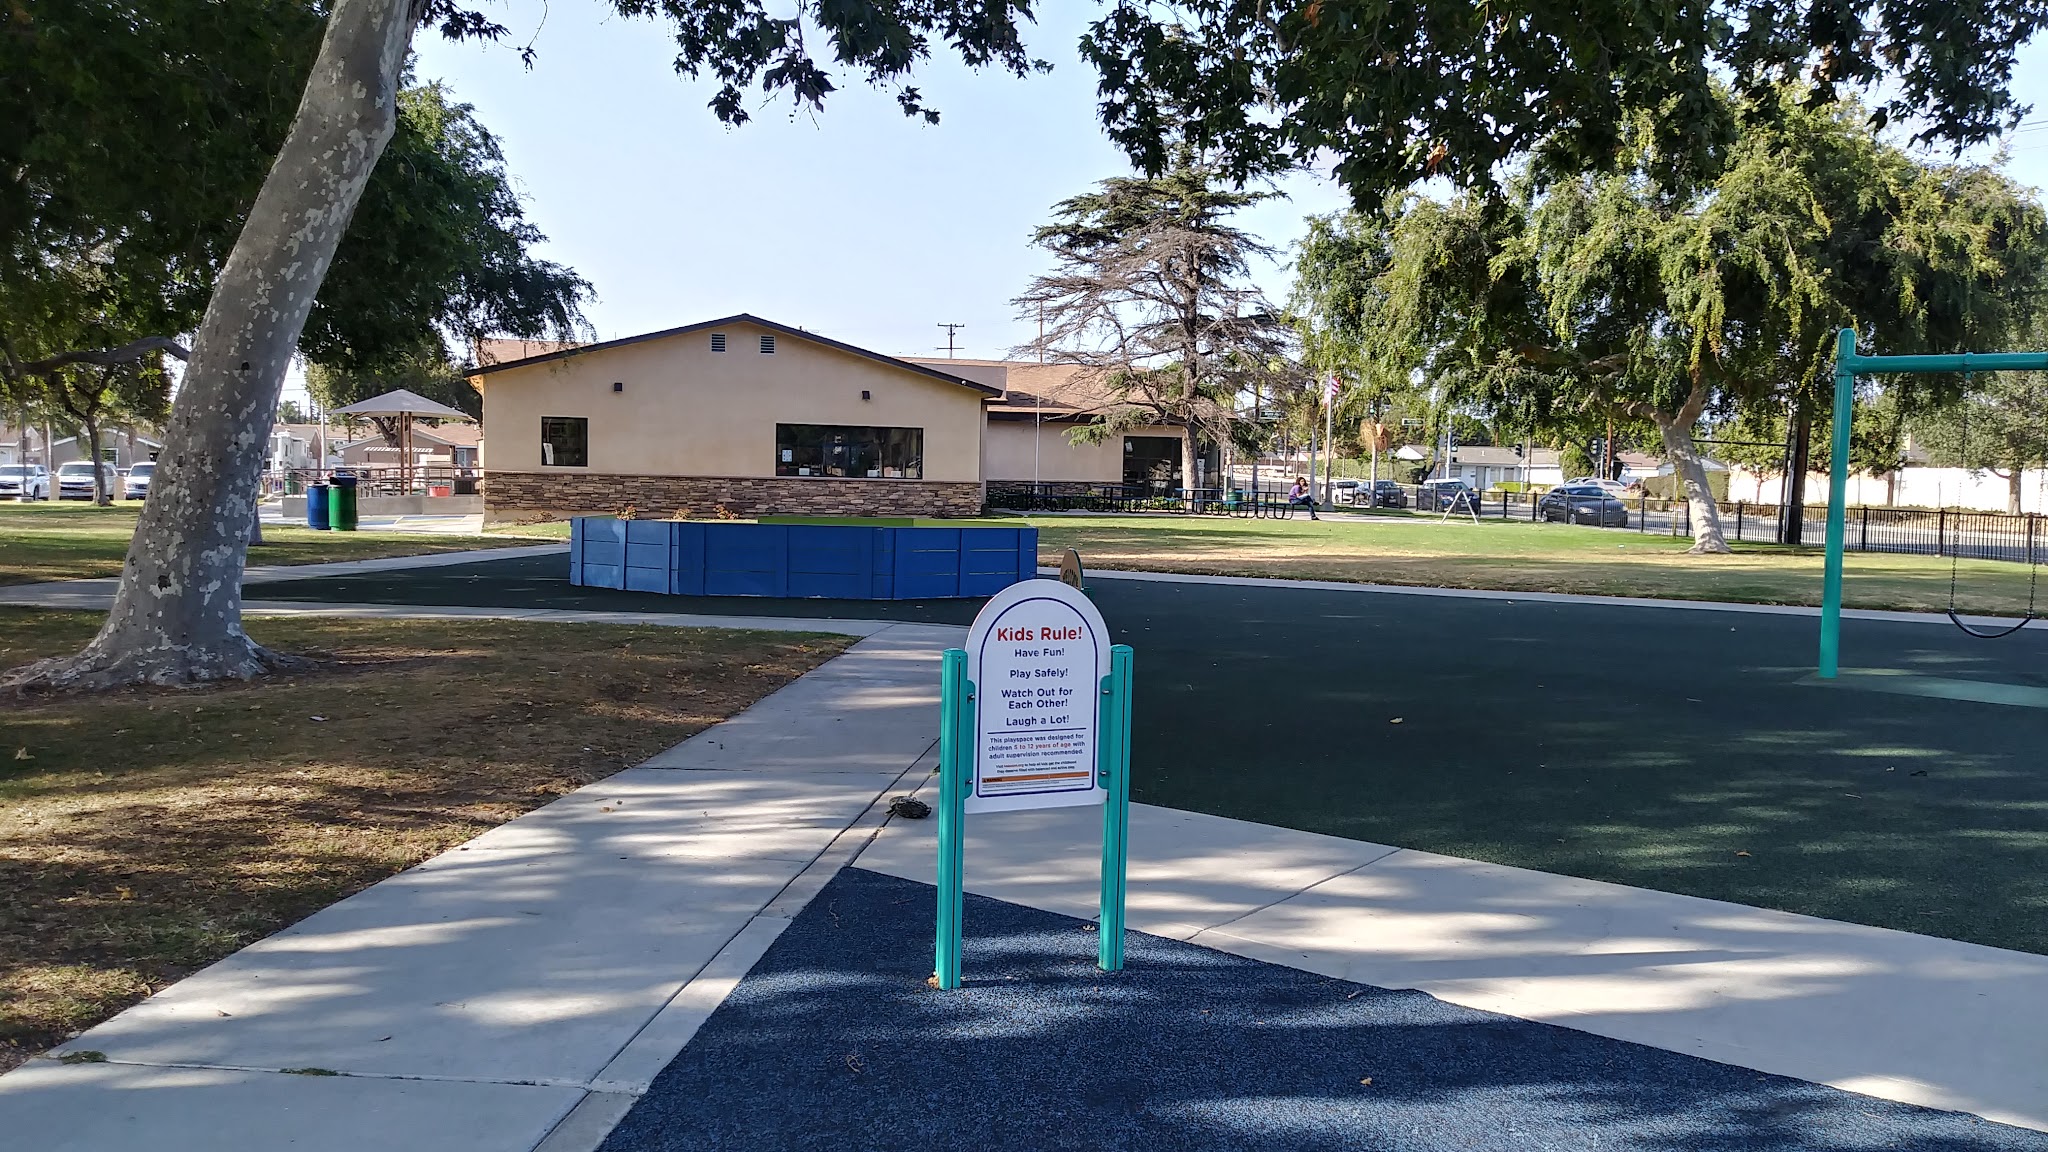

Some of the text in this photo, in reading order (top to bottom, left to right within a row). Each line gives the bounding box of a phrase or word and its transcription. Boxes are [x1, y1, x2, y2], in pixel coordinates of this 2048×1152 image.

[997, 626, 1082, 642] Kids Rule!
[1014, 648, 1064, 658] Have Fun!
[1010, 668, 1068, 680] Play Safely!
[1001, 687, 1073, 698] Watch Out for
[1008, 698, 1068, 710] Each Other!
[1006, 716, 1037, 726] Laugh
[1050, 714, 1070, 724] Lot!
